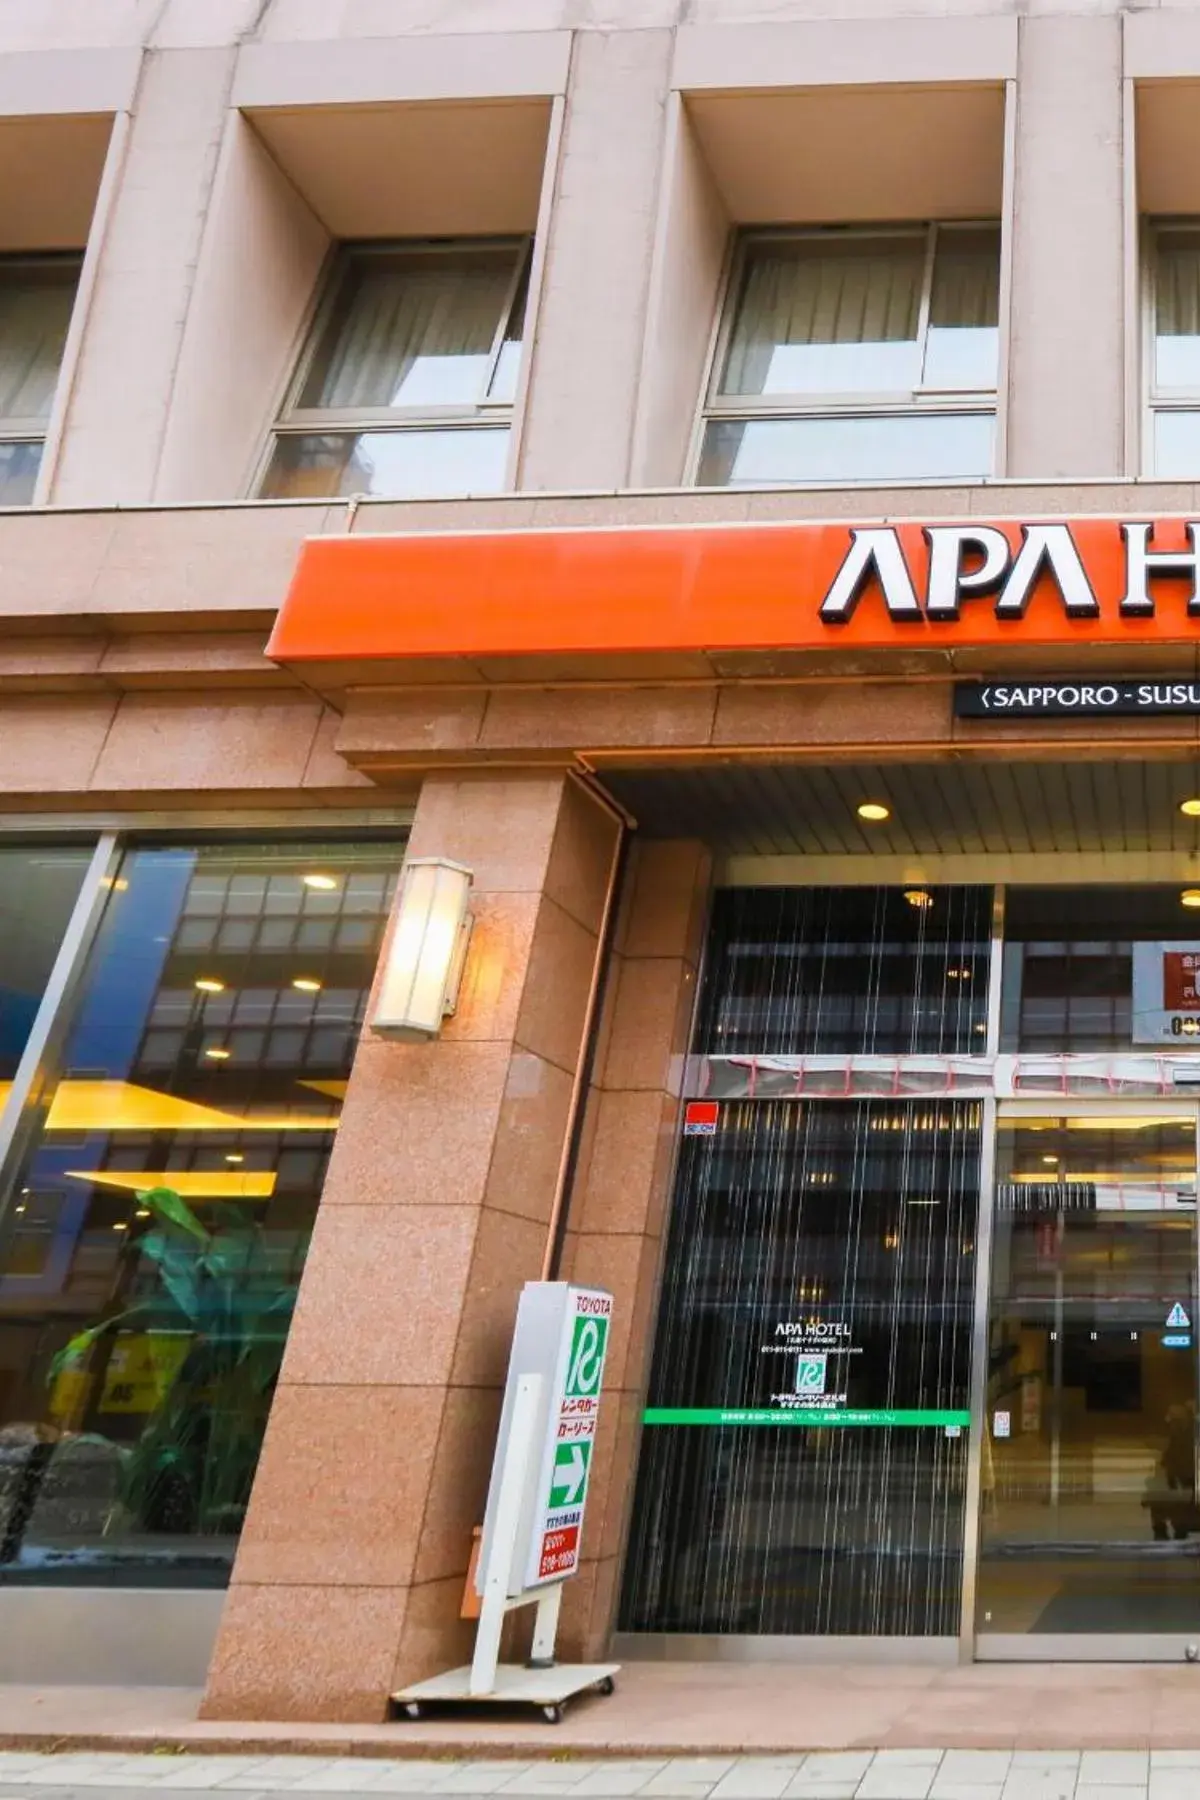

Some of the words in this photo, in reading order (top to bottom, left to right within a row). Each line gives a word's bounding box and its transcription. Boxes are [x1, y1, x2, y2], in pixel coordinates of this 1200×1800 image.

[819, 524, 1100, 623] APA
[576, 1295, 611, 1314] TOYOTA
[775, 1323, 802, 1336] APA
[805, 1323, 852, 1336] HOTEL
